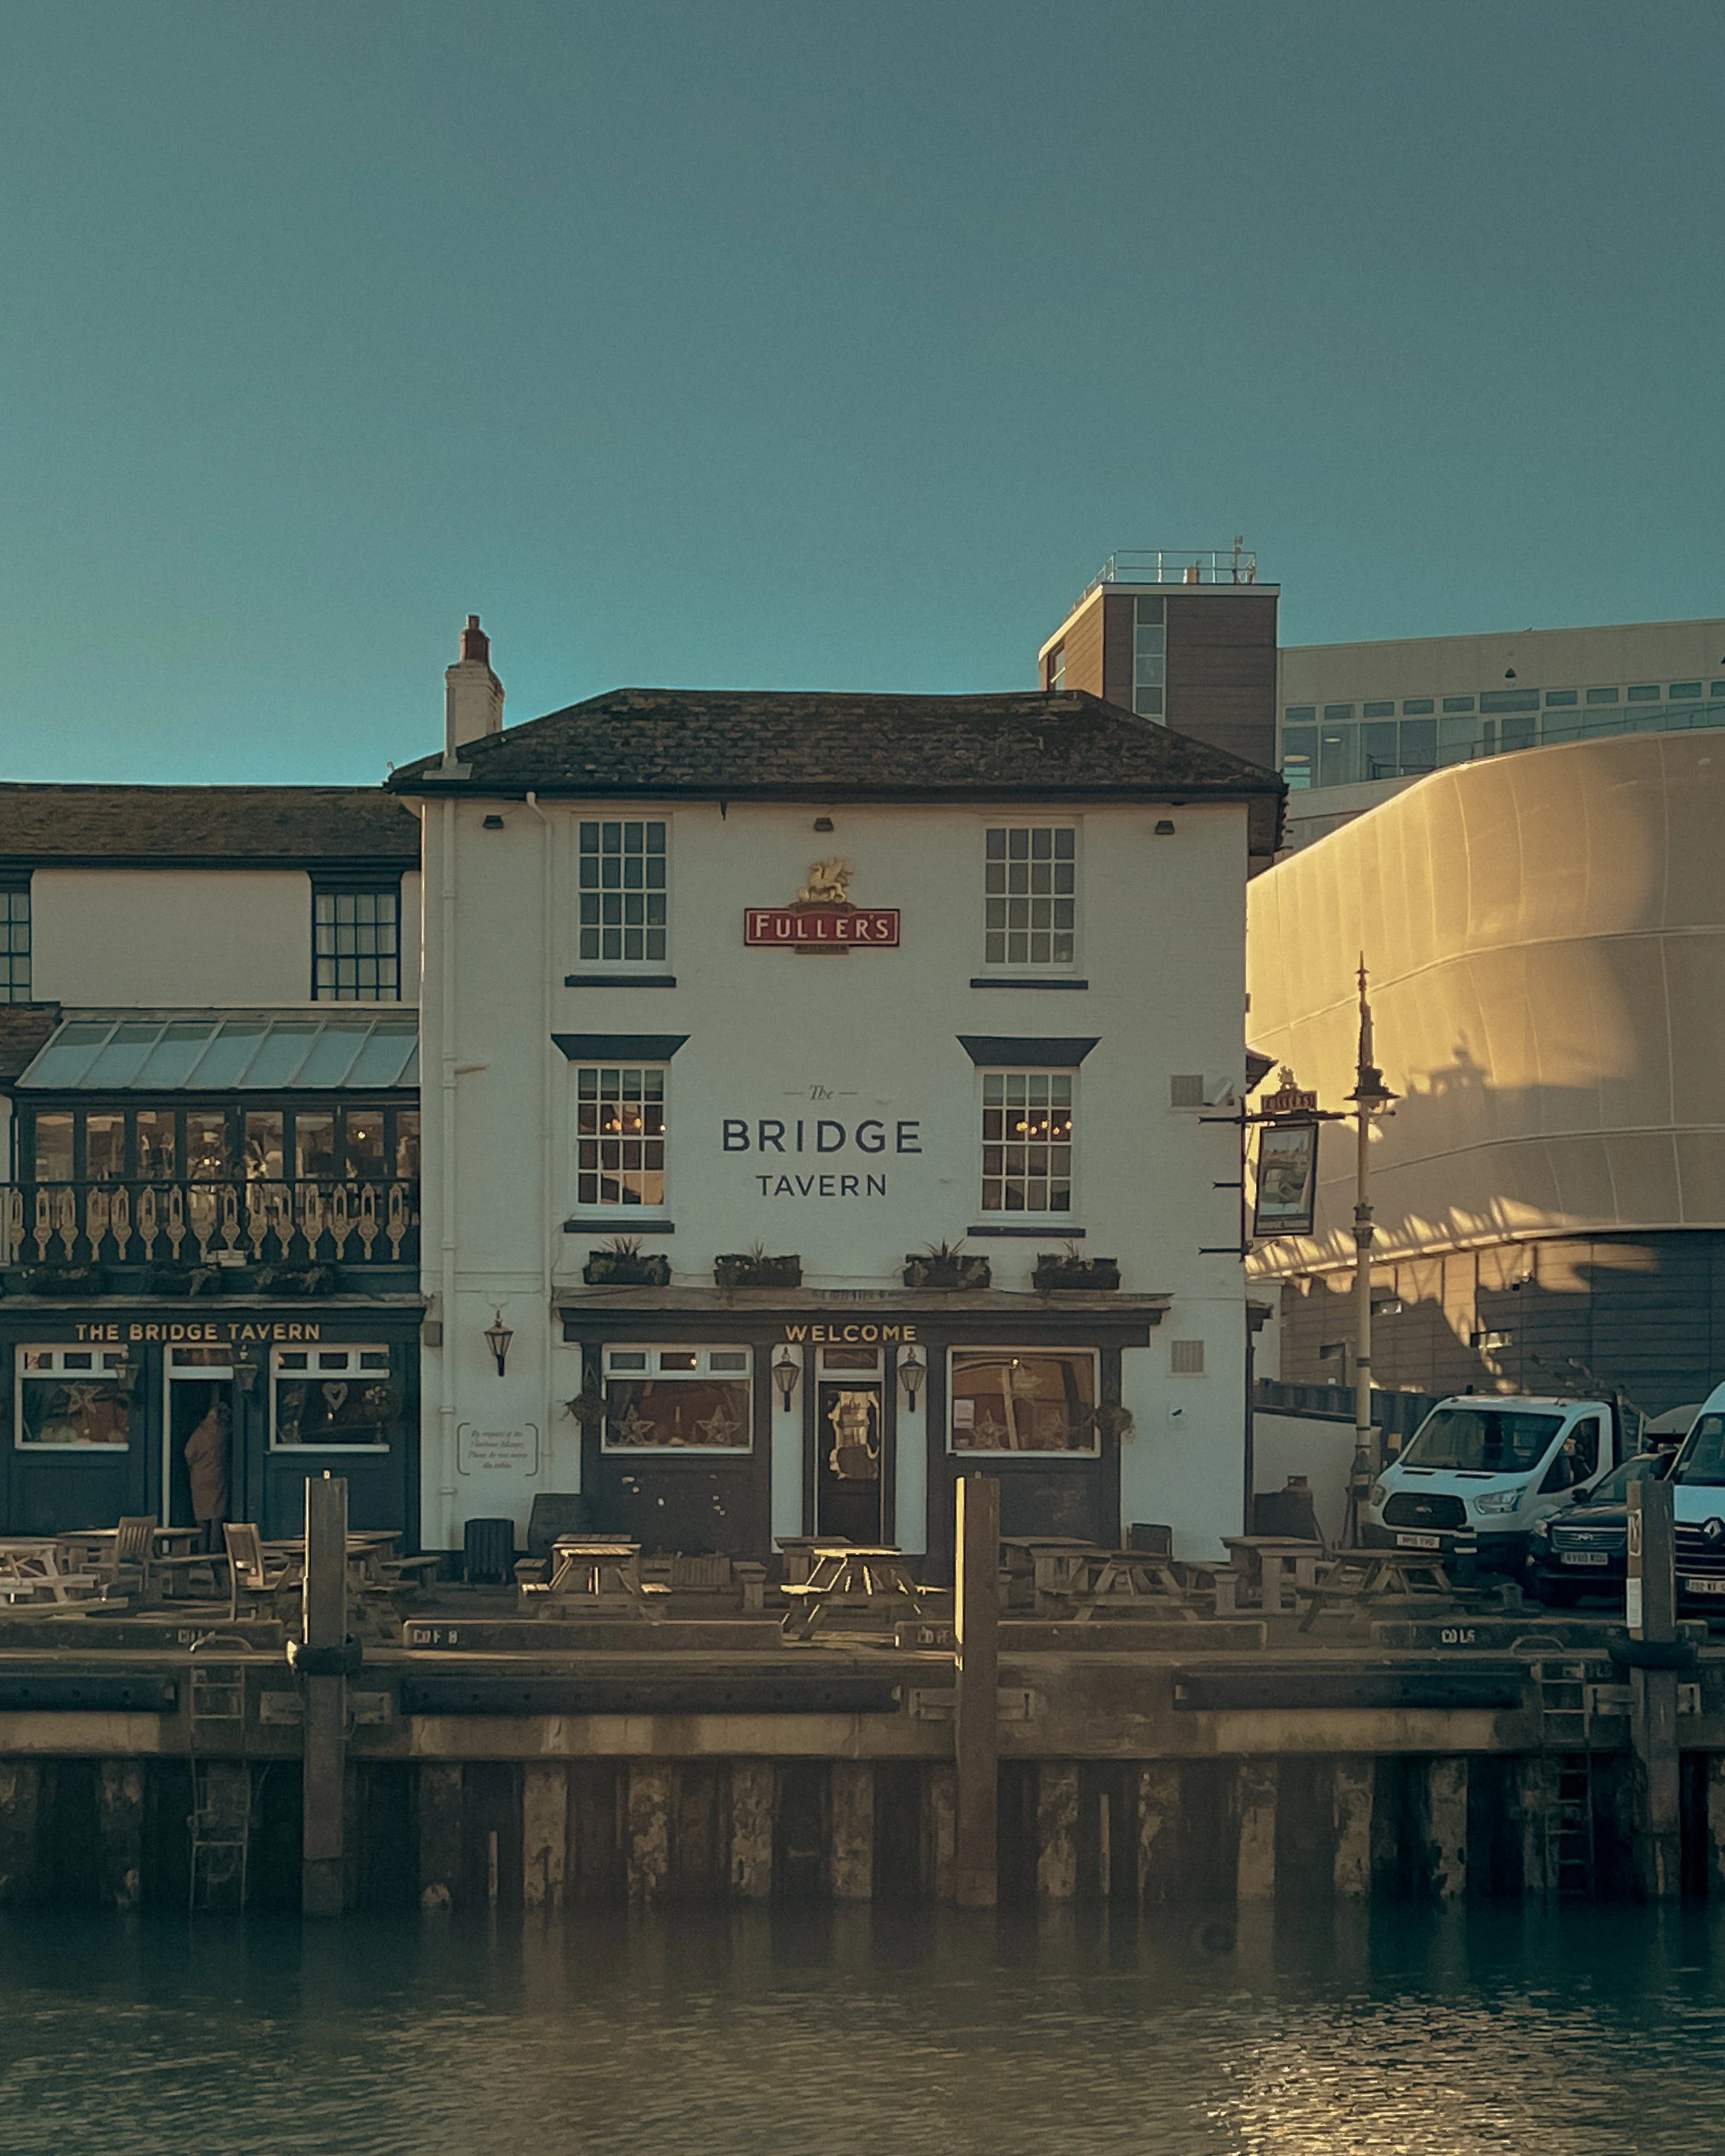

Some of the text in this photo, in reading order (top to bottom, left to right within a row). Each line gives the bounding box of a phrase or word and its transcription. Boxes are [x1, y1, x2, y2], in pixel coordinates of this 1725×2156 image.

[755, 914, 889, 941] FULLER'S
[808, 1085, 835, 1101] The
[722, 1119, 923, 1153] BRIDGE
[755, 1174, 886, 1197] TAVERN
[75, 1323, 320, 1341] THE BRIDGE TAVERN
[785, 1324, 918, 1342] WELCOME
